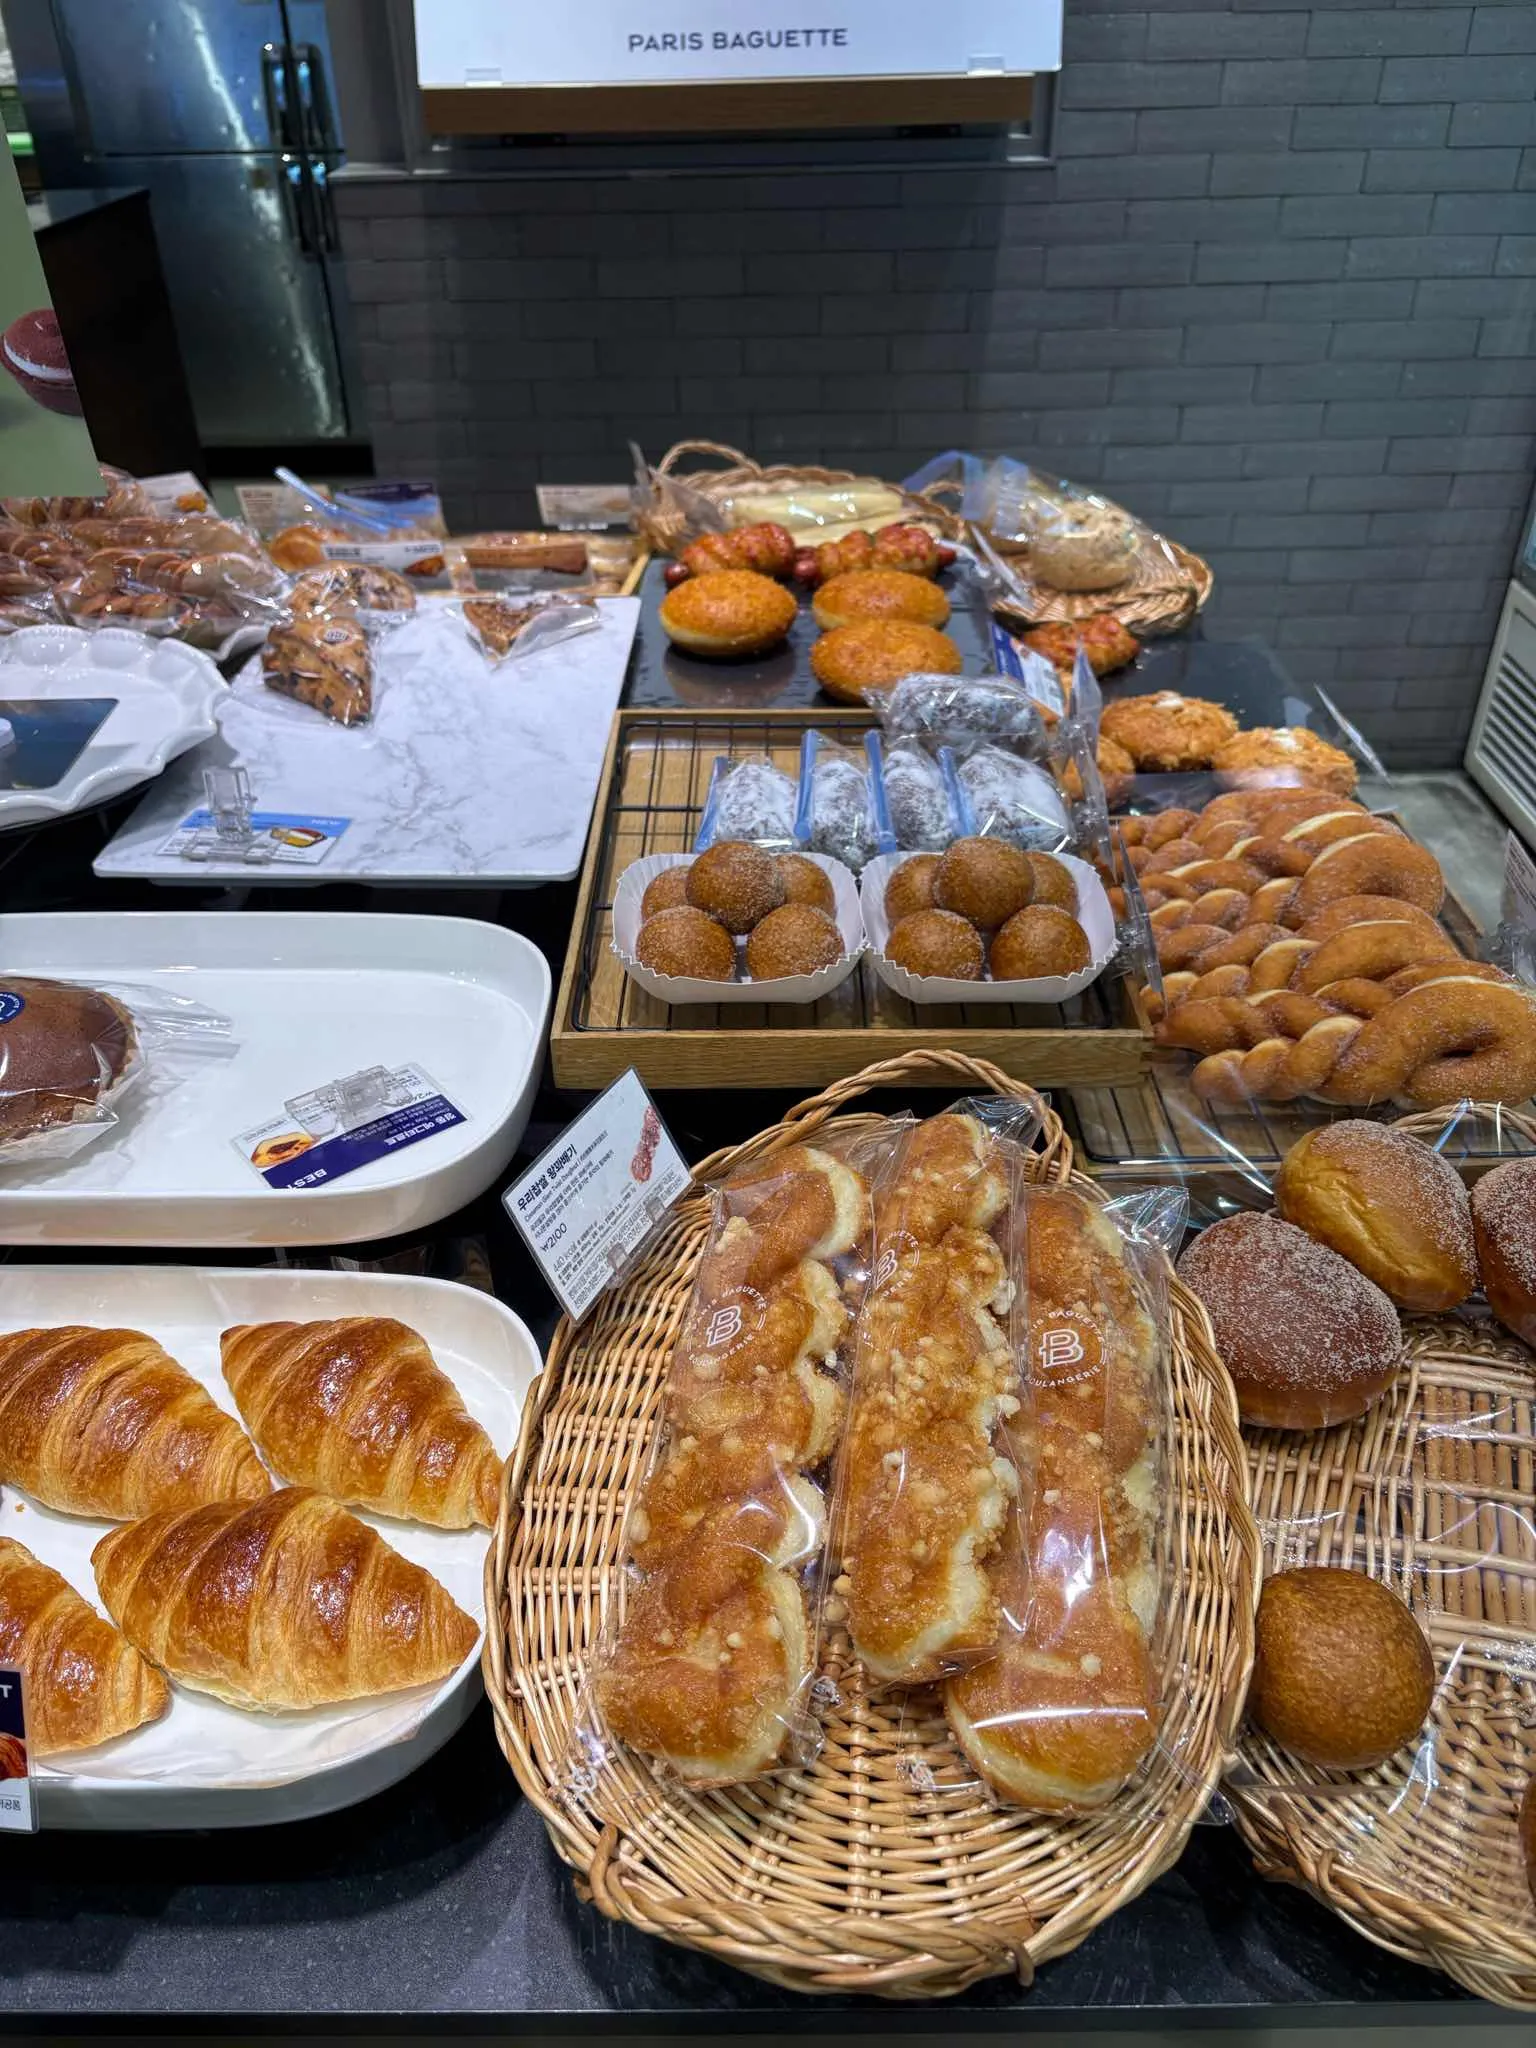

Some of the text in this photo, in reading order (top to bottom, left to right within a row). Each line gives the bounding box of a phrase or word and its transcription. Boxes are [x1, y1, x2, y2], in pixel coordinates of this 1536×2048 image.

[628, 28, 848, 52] PARIS BAGUETTE
[517, 1143, 577, 1211] 우리찹쌀 왕꽈배기
[721, 1284, 767, 1310] BAGUETTE
[1048, 1310, 1105, 1343] BAGUETTE
